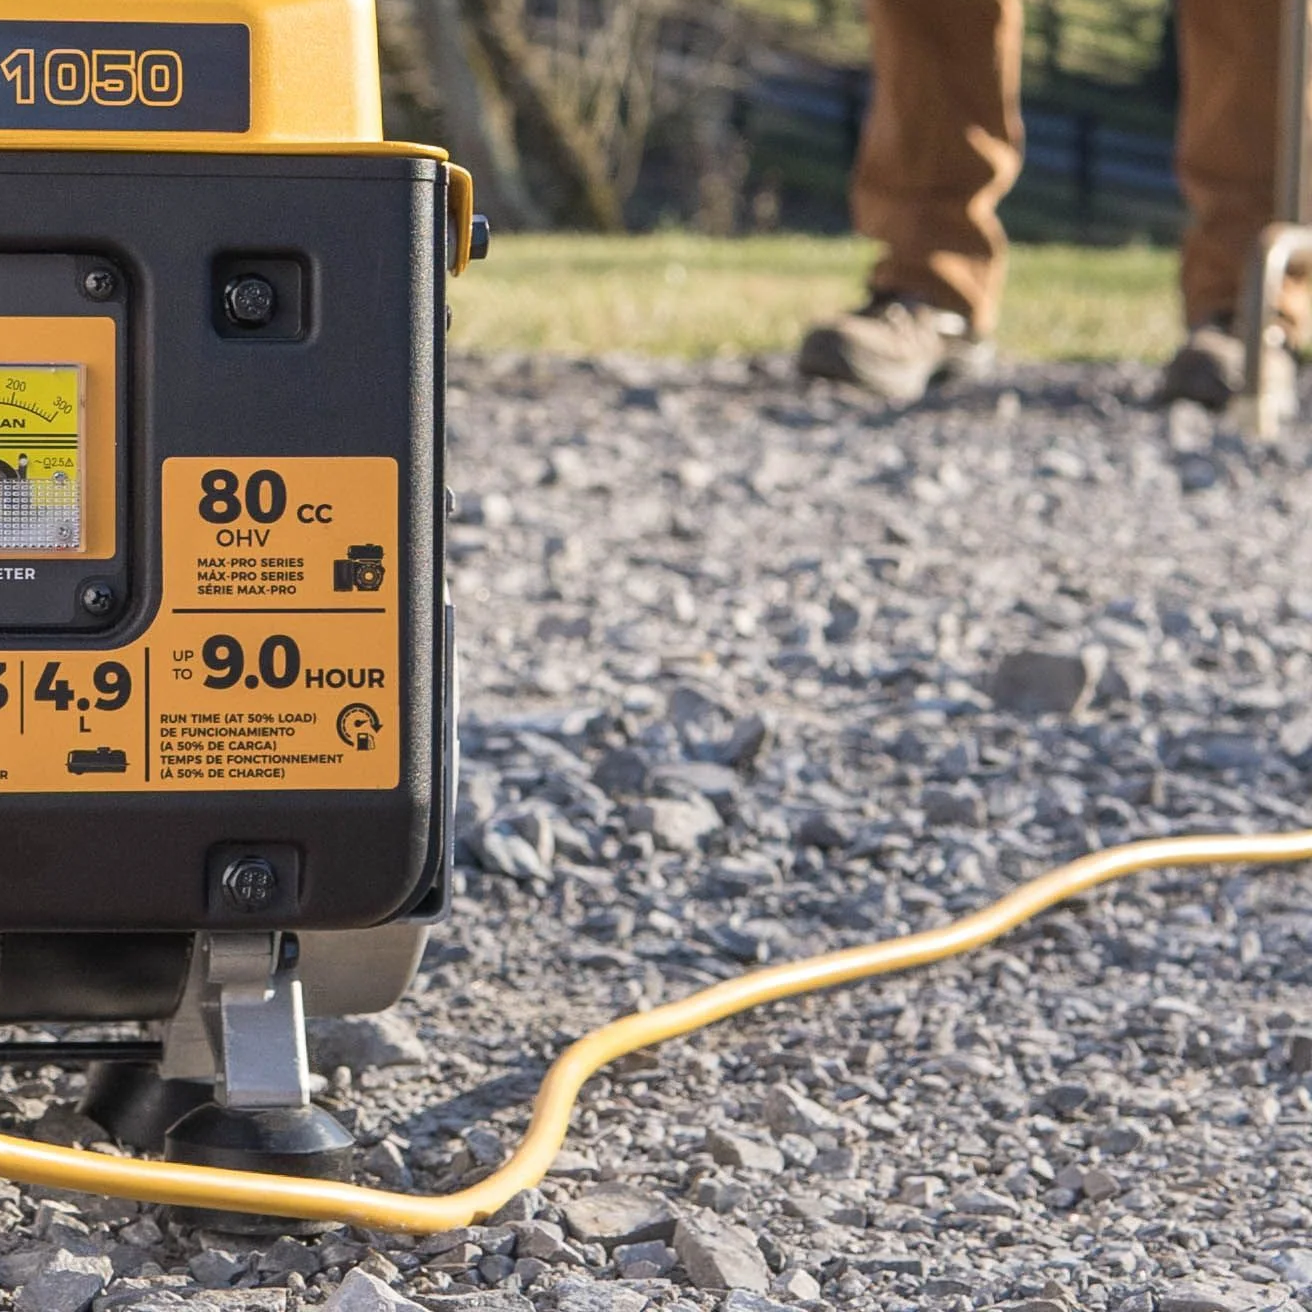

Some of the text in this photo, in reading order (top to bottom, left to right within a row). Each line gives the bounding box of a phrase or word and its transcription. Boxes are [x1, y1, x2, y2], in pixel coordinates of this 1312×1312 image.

[0, 48, 183, 107] 1050
[5, 378, 26, 392] 200
[52, 396, 72, 415] 300
[198, 468, 287, 525] 80
[216, 529, 271, 548] OHV
[197, 558, 304, 568] MAX-PRO SERIES
[260, 571, 304, 581] SERIES
[197, 583, 297, 595] SÉRIE MAX-PRO
[173, 650, 194, 663] UP
[201, 634, 385, 690] 9.0 HOUR
[173, 668, 193, 681] TO
[33, 660, 132, 712] 4.9
[79, 716, 91, 733] L
[160, 713, 317, 725] RUN TIME (AT 50% LOAD)
[160, 727, 295, 737] DE FUNCIONAMIENTO
[160, 740, 277, 752] (A 50% DE CARGA)
[160, 754, 344, 765] TEMPS DE FONCTIONNEMENT
[160, 767, 285, 780] (À 50% DE CHARGE)
